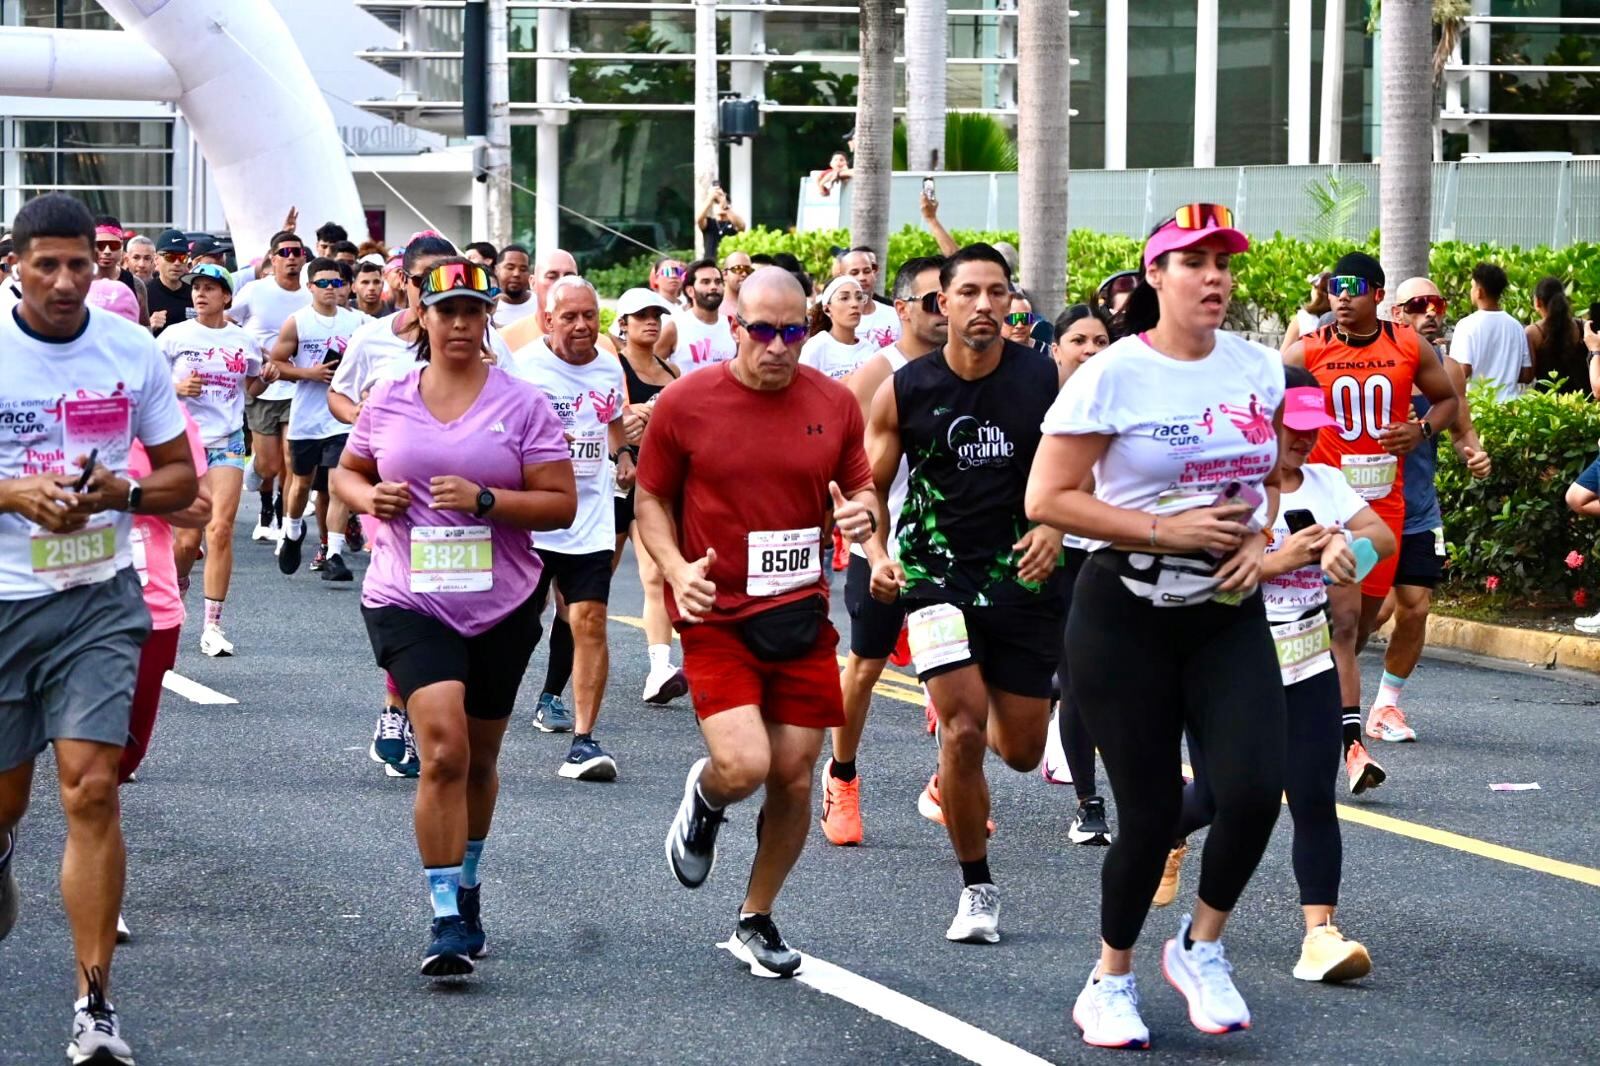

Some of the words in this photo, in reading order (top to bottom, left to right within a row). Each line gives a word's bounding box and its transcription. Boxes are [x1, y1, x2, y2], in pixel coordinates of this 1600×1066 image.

[1326, 360, 1395, 370] BENGALS
[1331, 373, 1392, 441] 00
[1153, 424, 1190, 440] race
[957, 431, 1014, 468] grande
[1351, 468, 1389, 485] 3067
[46, 533, 105, 567] 2963
[423, 544, 478, 569] 3321
[761, 547, 811, 573] 8508
[1280, 631, 1322, 664] 2993
